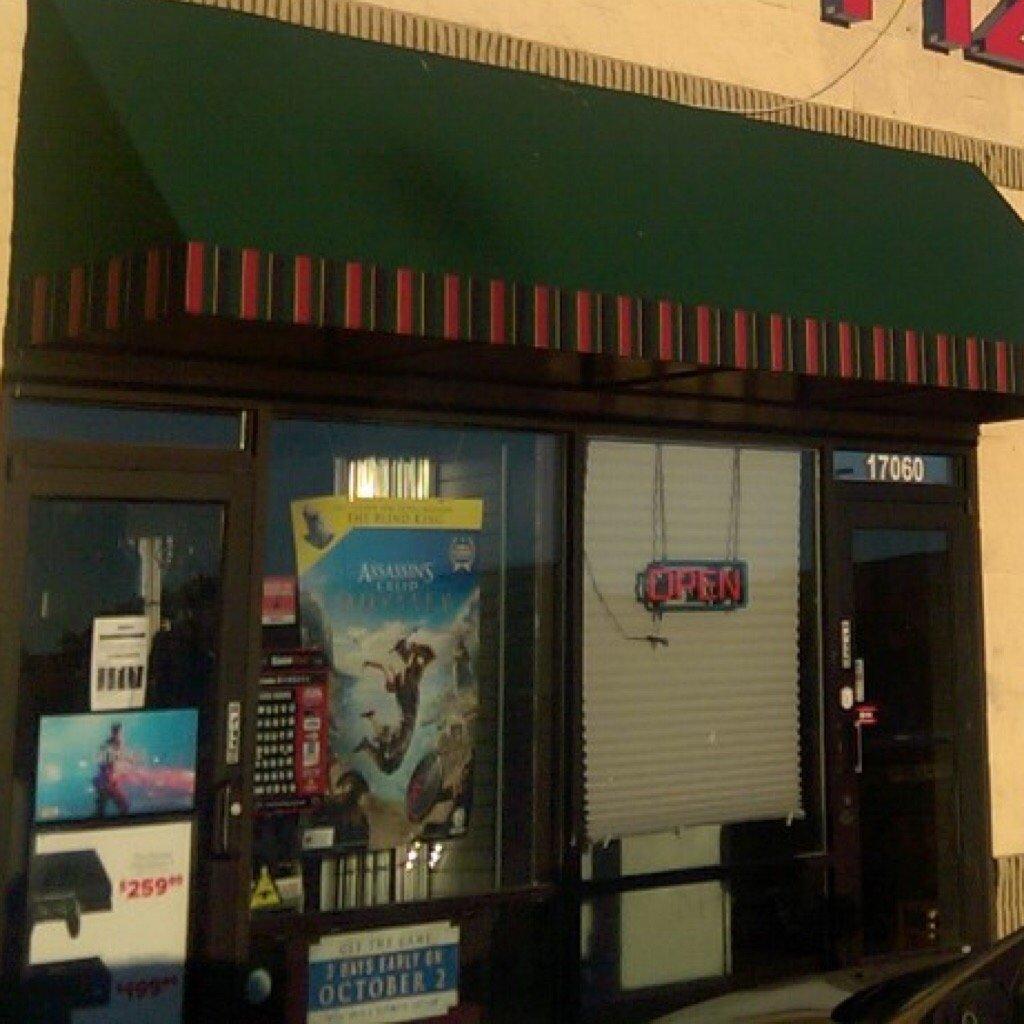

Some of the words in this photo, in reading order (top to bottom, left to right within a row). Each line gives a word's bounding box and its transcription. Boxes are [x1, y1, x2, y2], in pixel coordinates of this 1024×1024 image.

[866, 452, 925, 483] 17060
[646, 565, 742, 603] OPEN
[319, 969, 425, 1006] OCTOBER
